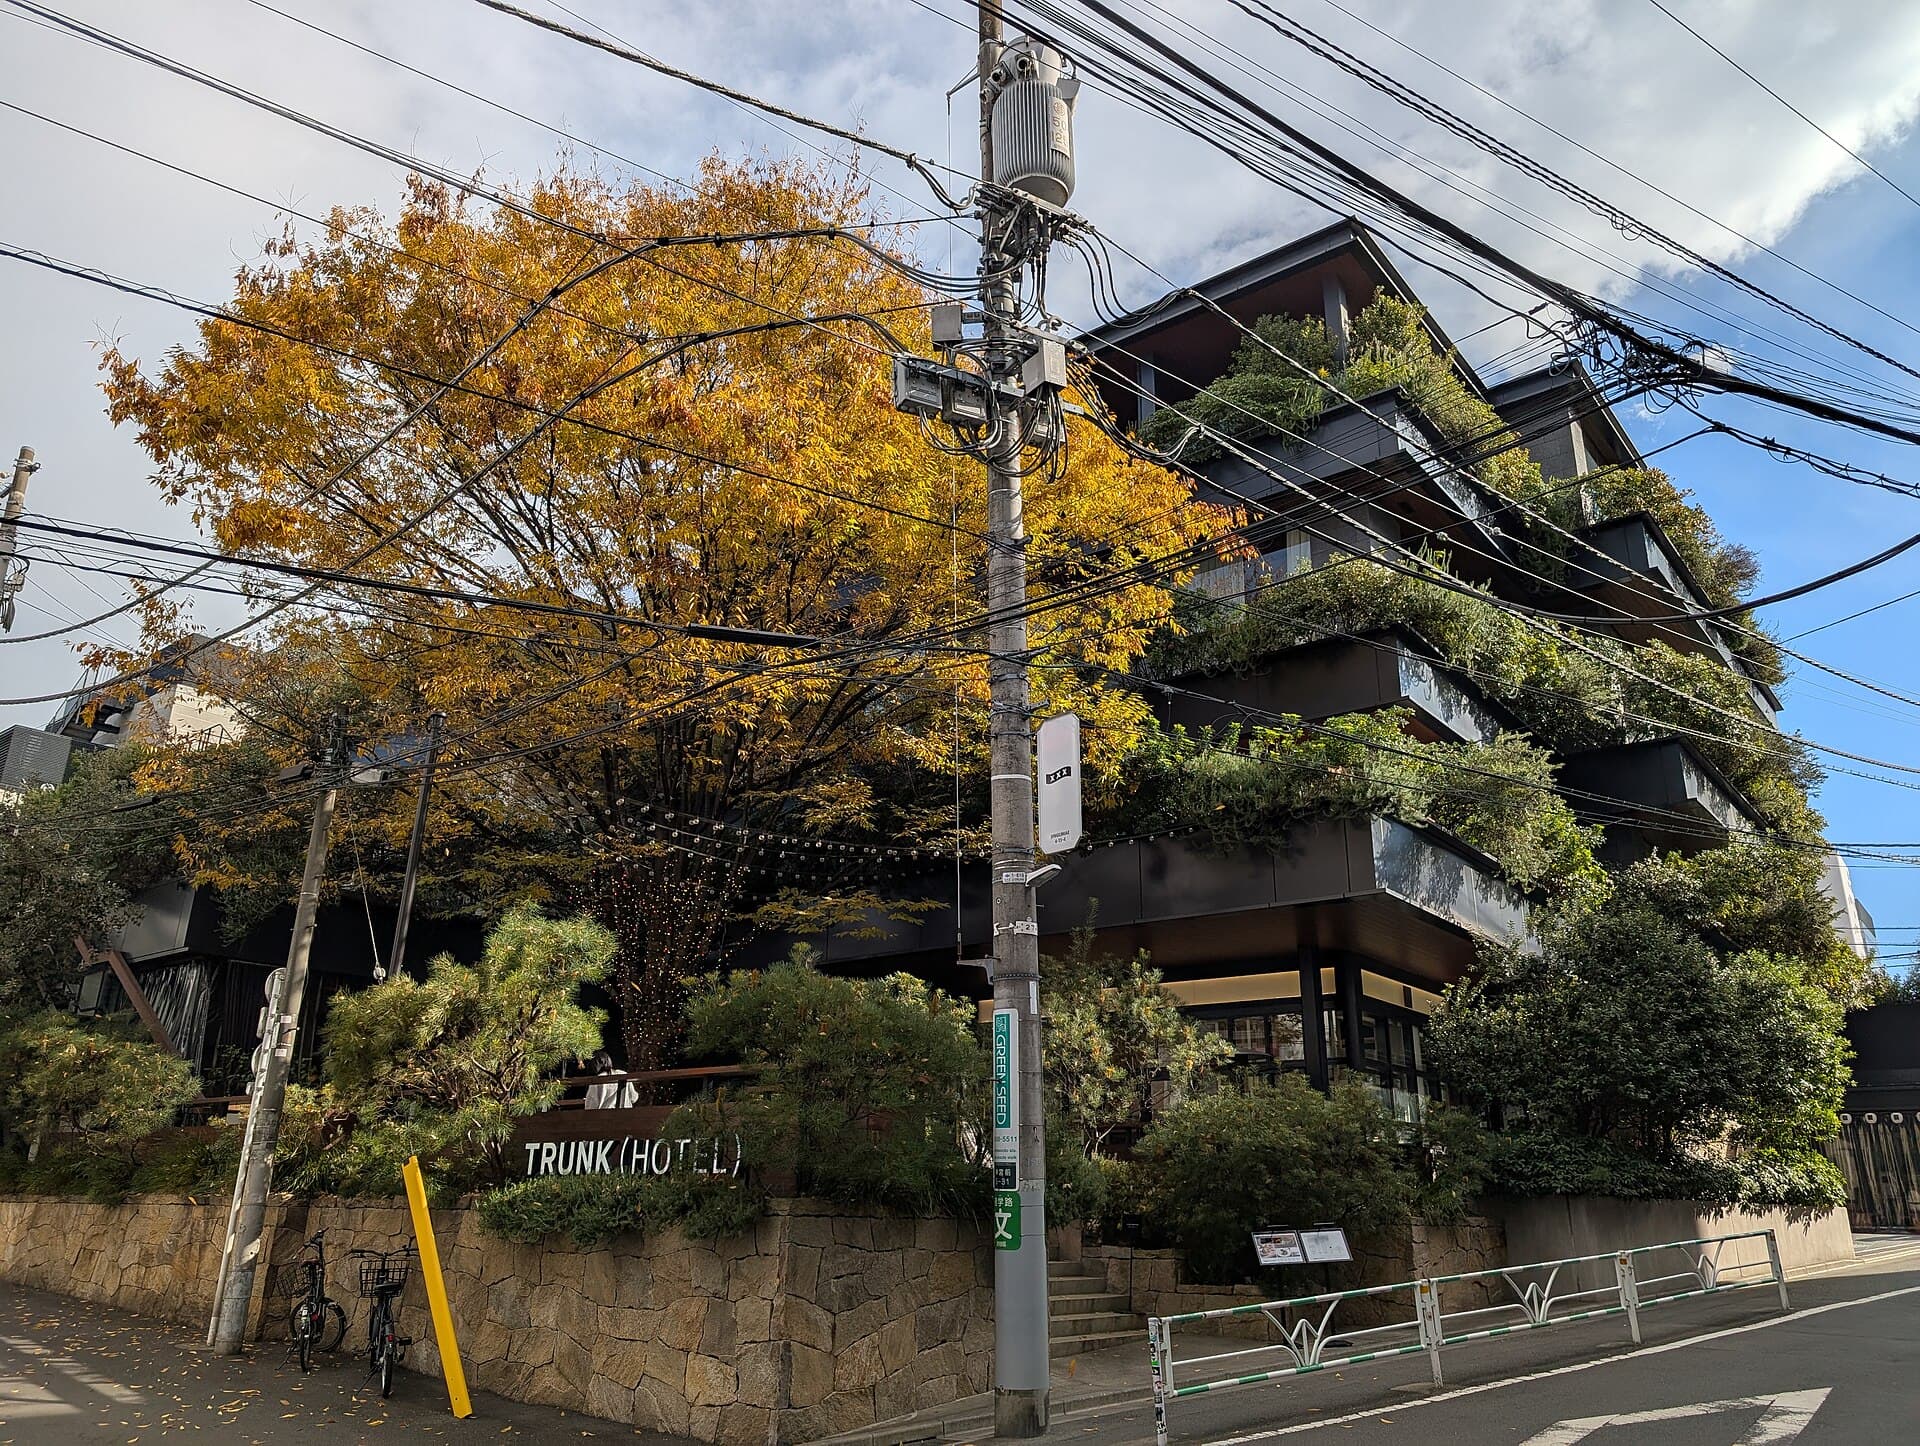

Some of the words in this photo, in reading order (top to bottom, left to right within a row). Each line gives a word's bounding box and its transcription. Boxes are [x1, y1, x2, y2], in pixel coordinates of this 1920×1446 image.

[996, 1034, 1006, 1083] GREEN
[996, 1086, 1006, 1125] SEED
[525, 1140, 614, 1175] TRUNK
[995, 1194, 1013, 1207] 学路
[995, 1207, 1013, 1240] 文
